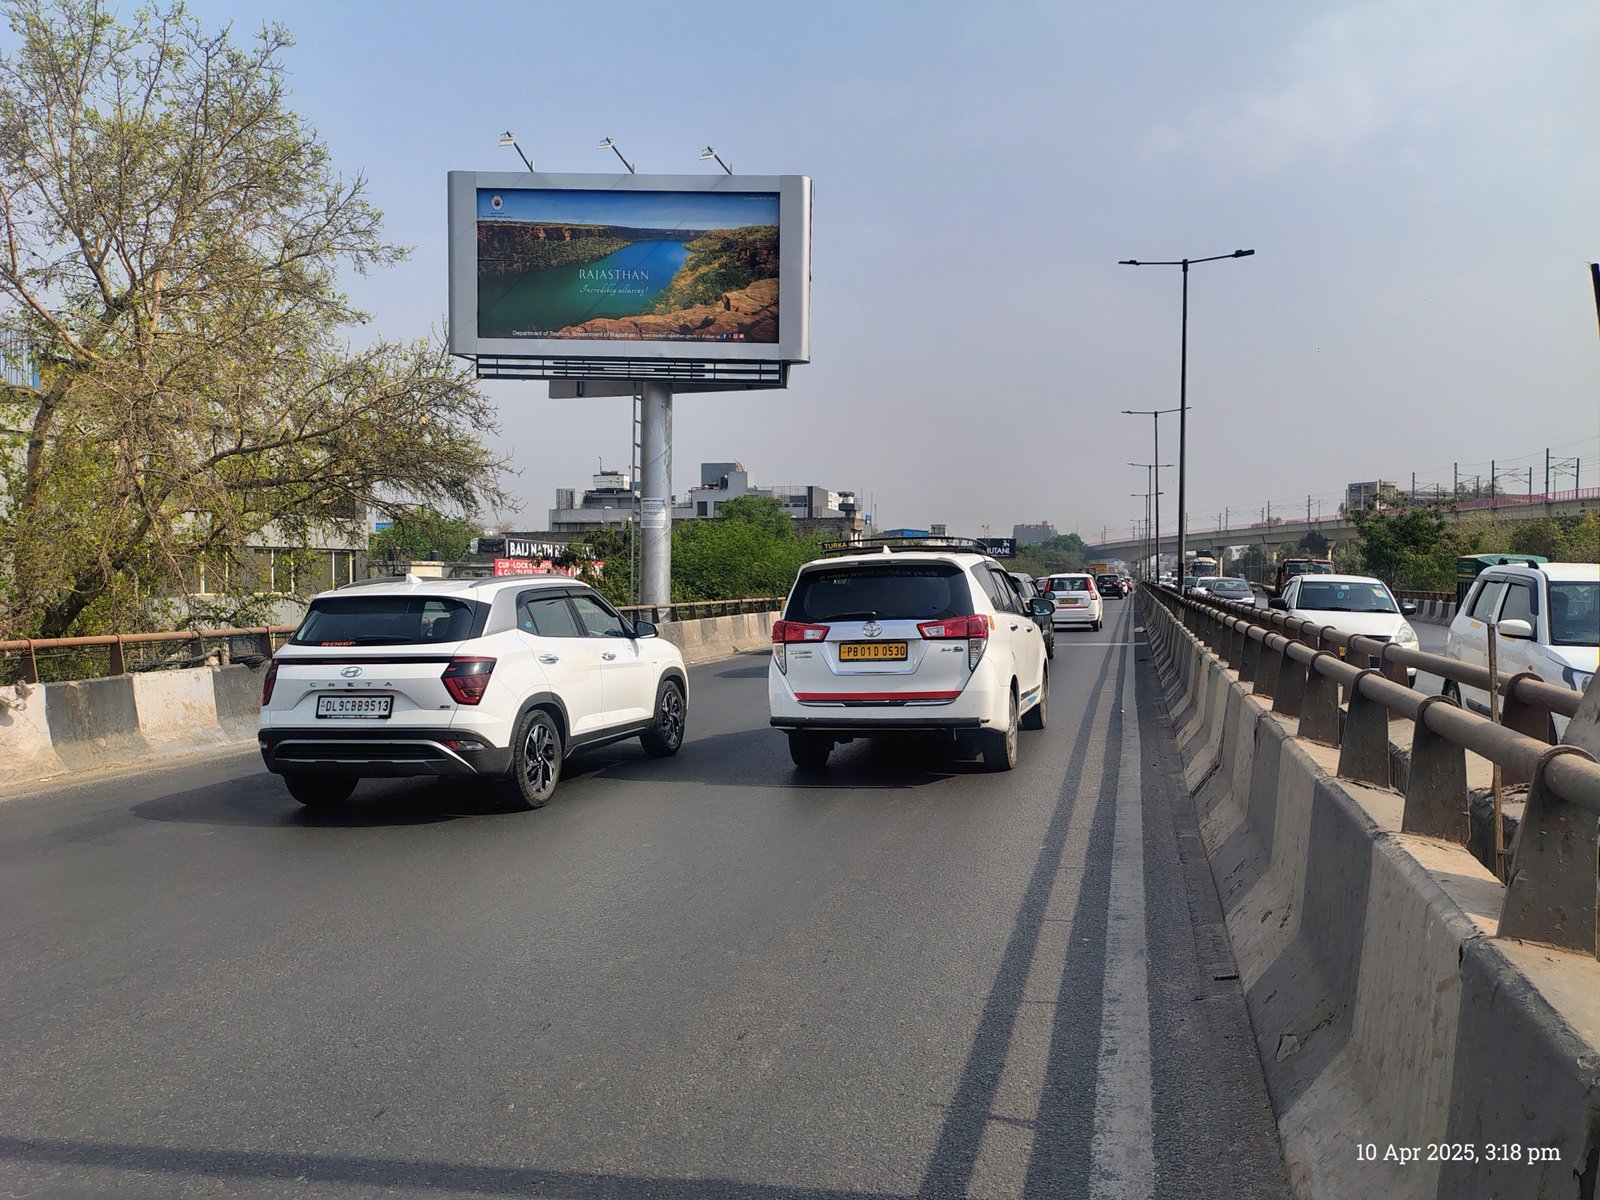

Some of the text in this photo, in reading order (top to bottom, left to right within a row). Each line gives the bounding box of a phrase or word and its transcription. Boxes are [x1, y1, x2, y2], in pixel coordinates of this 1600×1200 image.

[580, 269, 649, 280] RAJASTHAN
[580, 283, 649, 296] Incredibly alluring!
[510, 542, 529, 556] BAIJ
[531, 543, 553, 557] NATH
[823, 542, 847, 550] TURKA
[847, 647, 858, 657] PB
[860, 646, 871, 657] 01
[882, 646, 906, 657] 0530
[326, 700, 389, 712] DL9CBB9513
